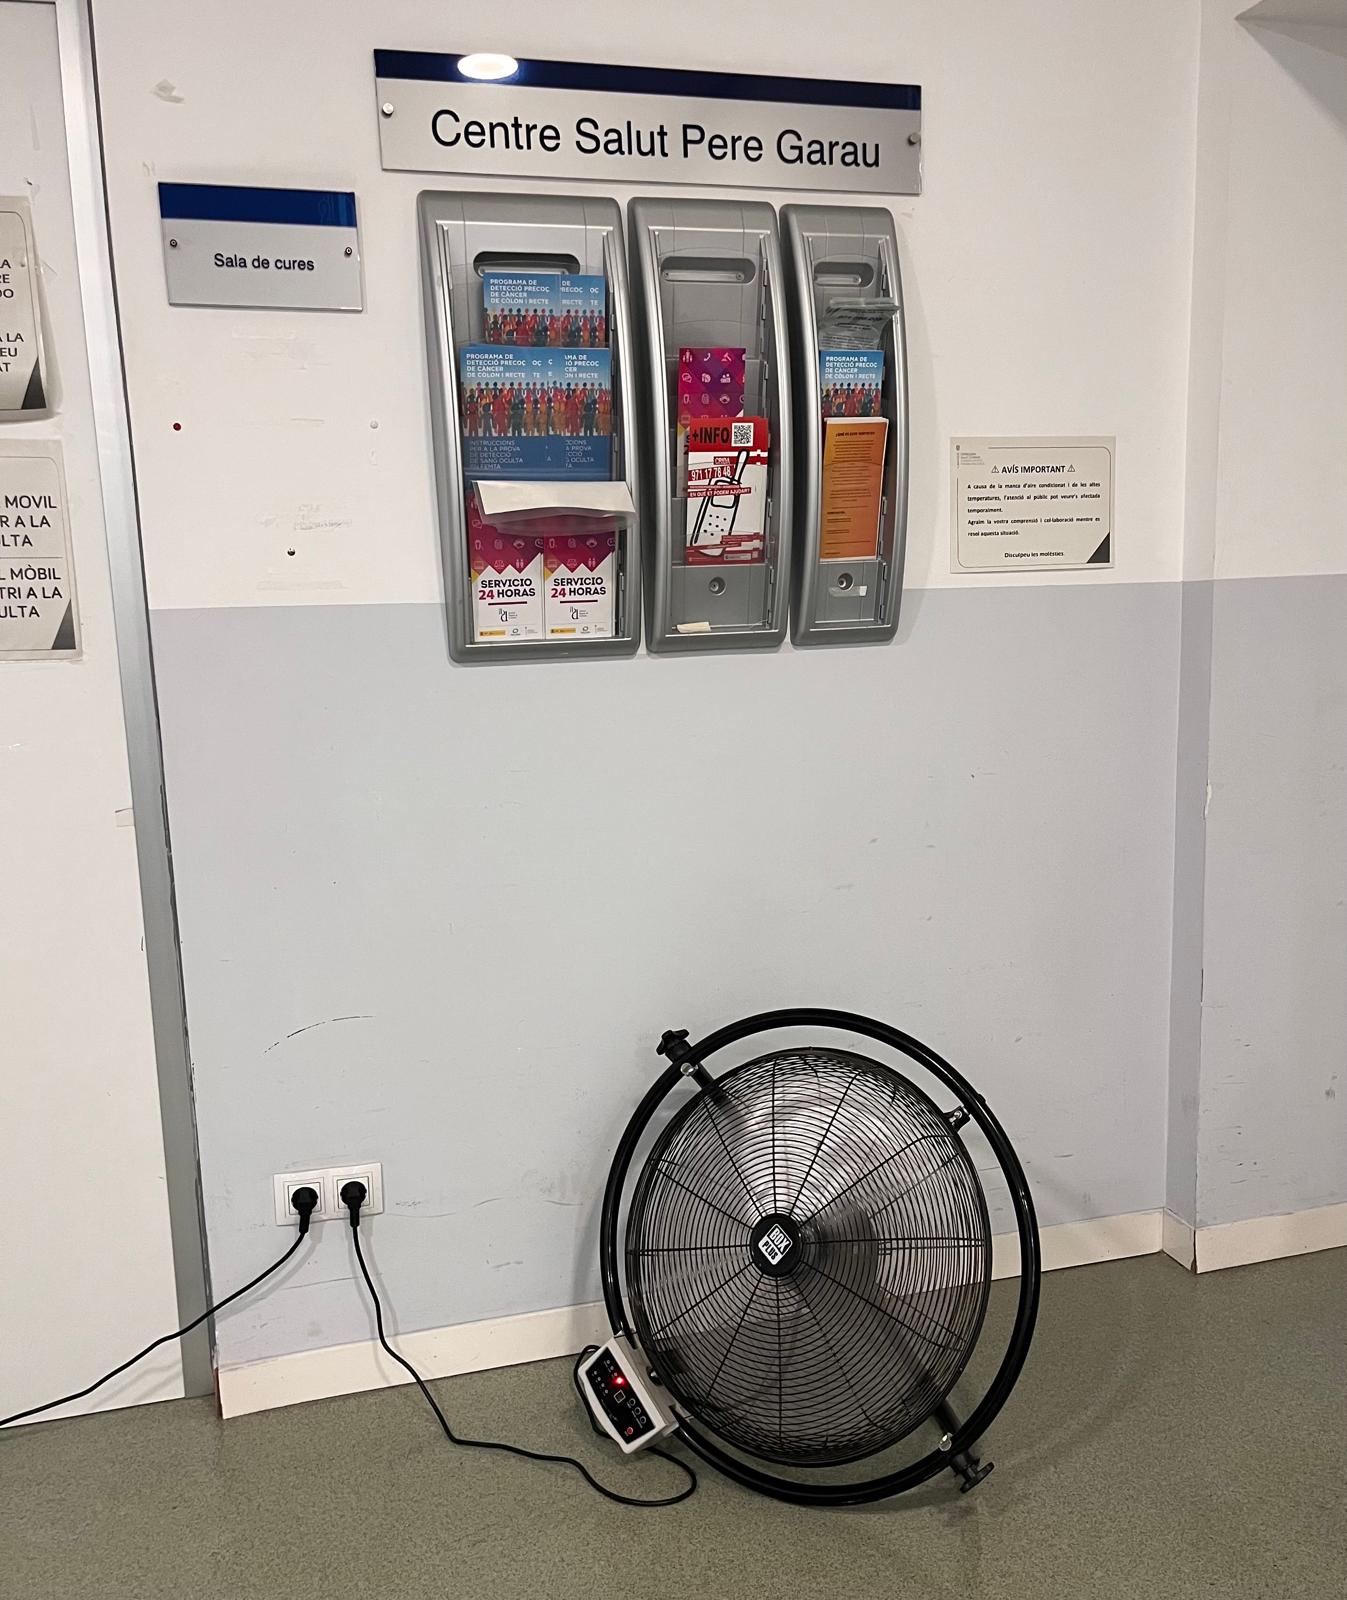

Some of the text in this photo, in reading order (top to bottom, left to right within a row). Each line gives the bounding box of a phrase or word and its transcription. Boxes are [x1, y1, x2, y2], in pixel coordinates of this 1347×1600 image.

[431, 109, 882, 169] Centre Salut Pere Garau
[0, 259, 11, 269] A
[214, 252, 315, 271] Sala de cures
[0, 274, 10, 284] E
[6, 332, 25, 343] LA
[0, 362, 11, 372] T
[692, 426, 730, 444] +INFO
[692, 470, 702, 480] 971
[705, 468, 712, 479] 17
[714, 467, 722, 478] 78
[1002, 464, 1066, 474] AVÍS IMPORTANT
[5, 495, 57, 509] MOVIL
[15, 515, 26, 528] A
[30, 515, 51, 528] LA
[10, 564, 62, 580] MÒBIL
[481, 578, 532, 589] SERVICIO
[553, 576, 604, 587] SERVICIO
[27, 586, 38, 599] A
[42, 586, 63, 599] LA
[478, 588, 536, 600] 24 HORAS
[551, 586, 606, 598] 24 HORAS
[769, 1227, 790, 1253] BOX
[762, 1240, 779, 1260] PLUS
